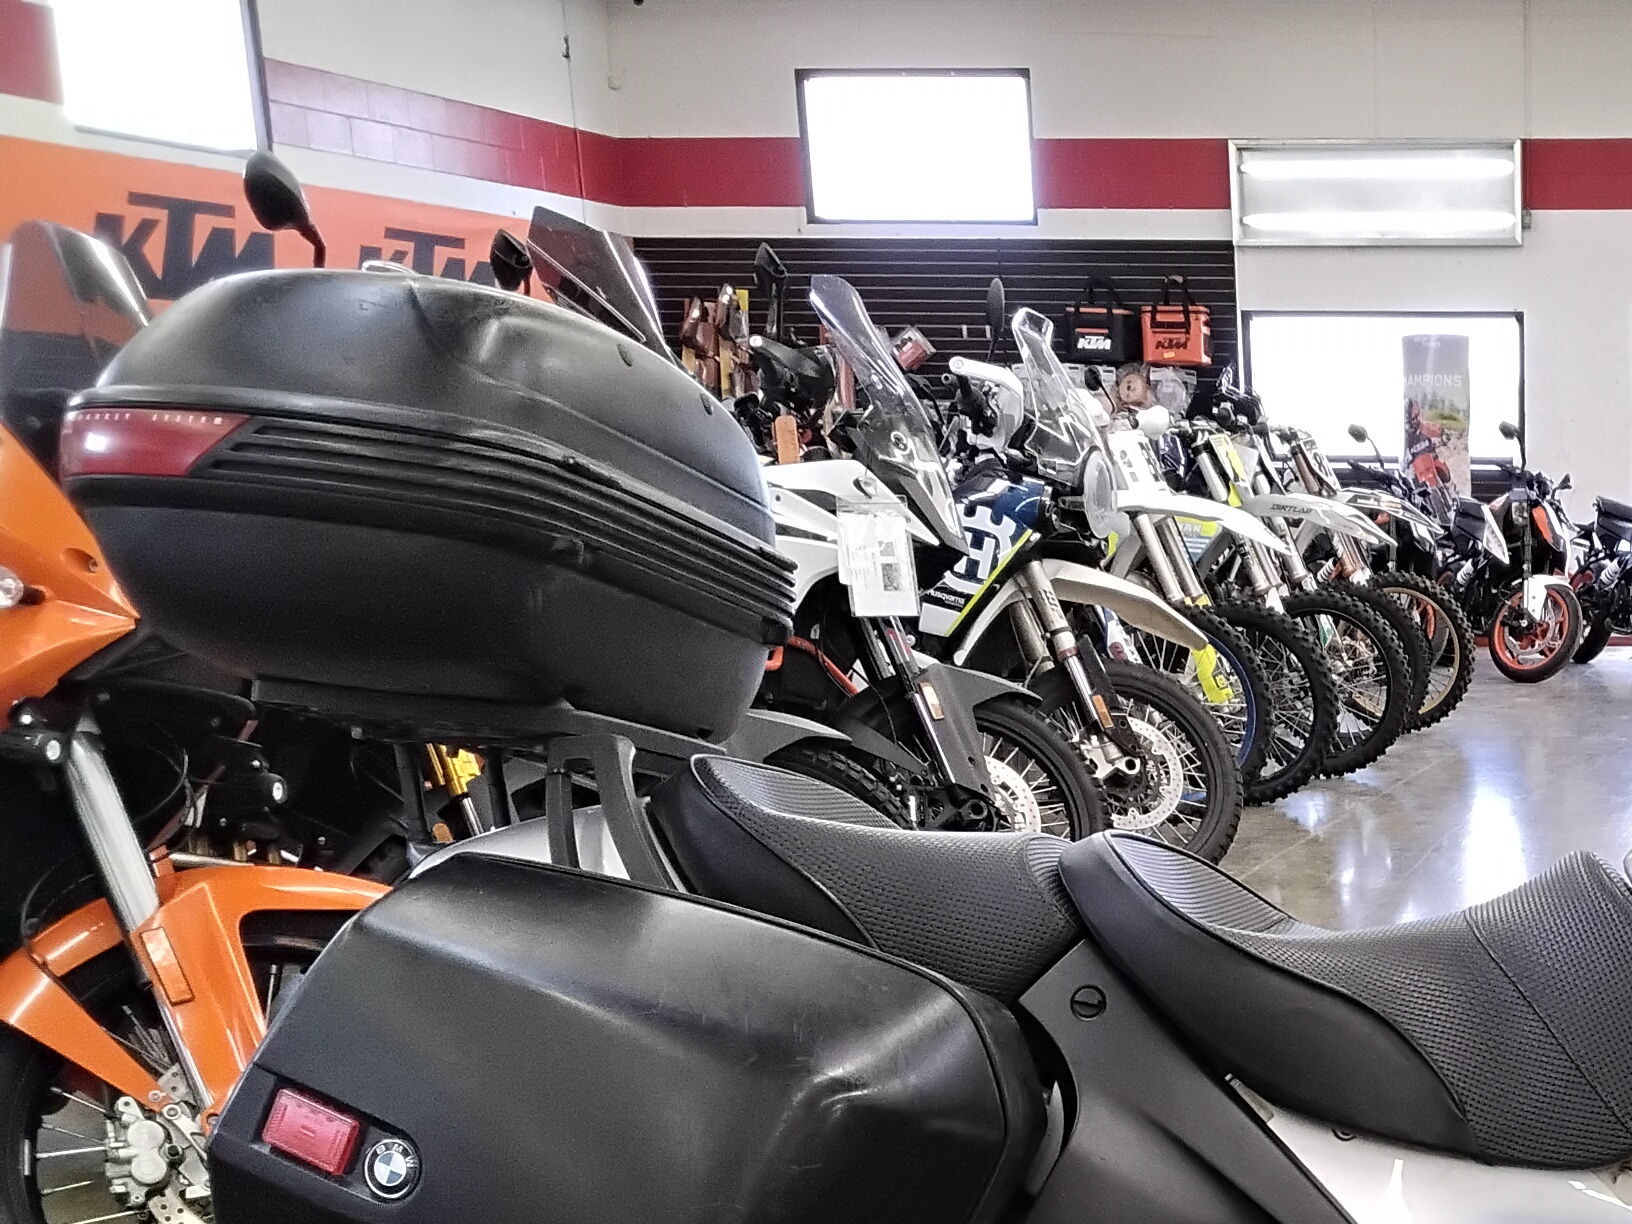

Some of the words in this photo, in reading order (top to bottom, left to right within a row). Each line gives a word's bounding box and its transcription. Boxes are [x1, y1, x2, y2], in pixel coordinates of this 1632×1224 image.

[94, 191, 275, 299] KTM
[1077, 335, 1112, 350] KTM
[1404, 373, 1463, 387] HAMPIONS
[375, 1143, 416, 1168] BMW
